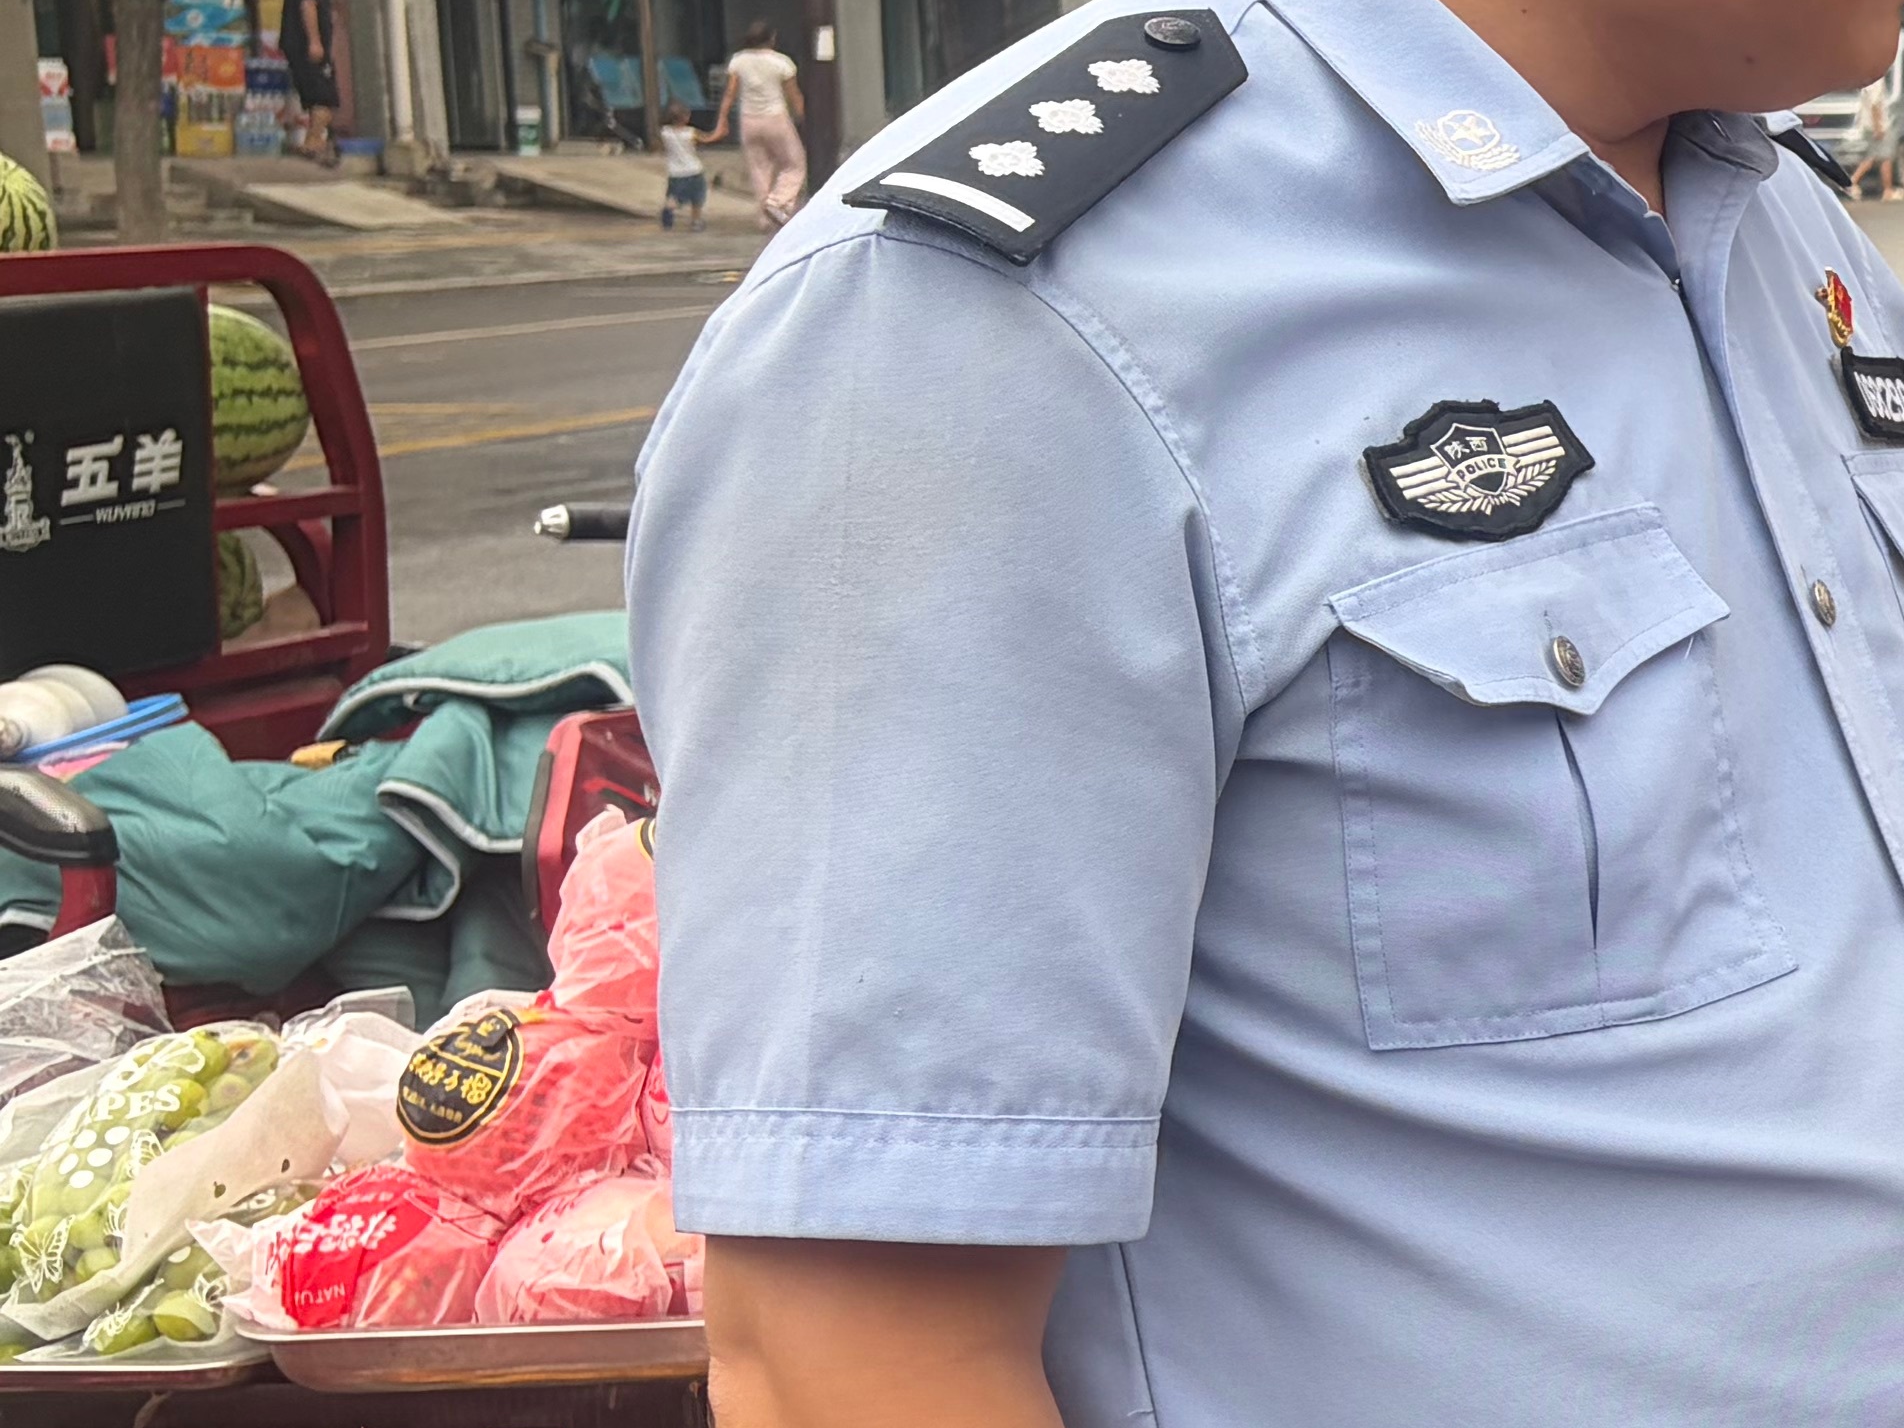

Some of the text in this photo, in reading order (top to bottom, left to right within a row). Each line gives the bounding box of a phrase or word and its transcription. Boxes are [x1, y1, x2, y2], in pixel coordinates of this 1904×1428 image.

[1443, 436, 1489, 460] 陕西
[60, 427, 184, 508] 五羊
[1455, 457, 1507, 483] POLICE
[96, 498, 157, 524] WUYANG
